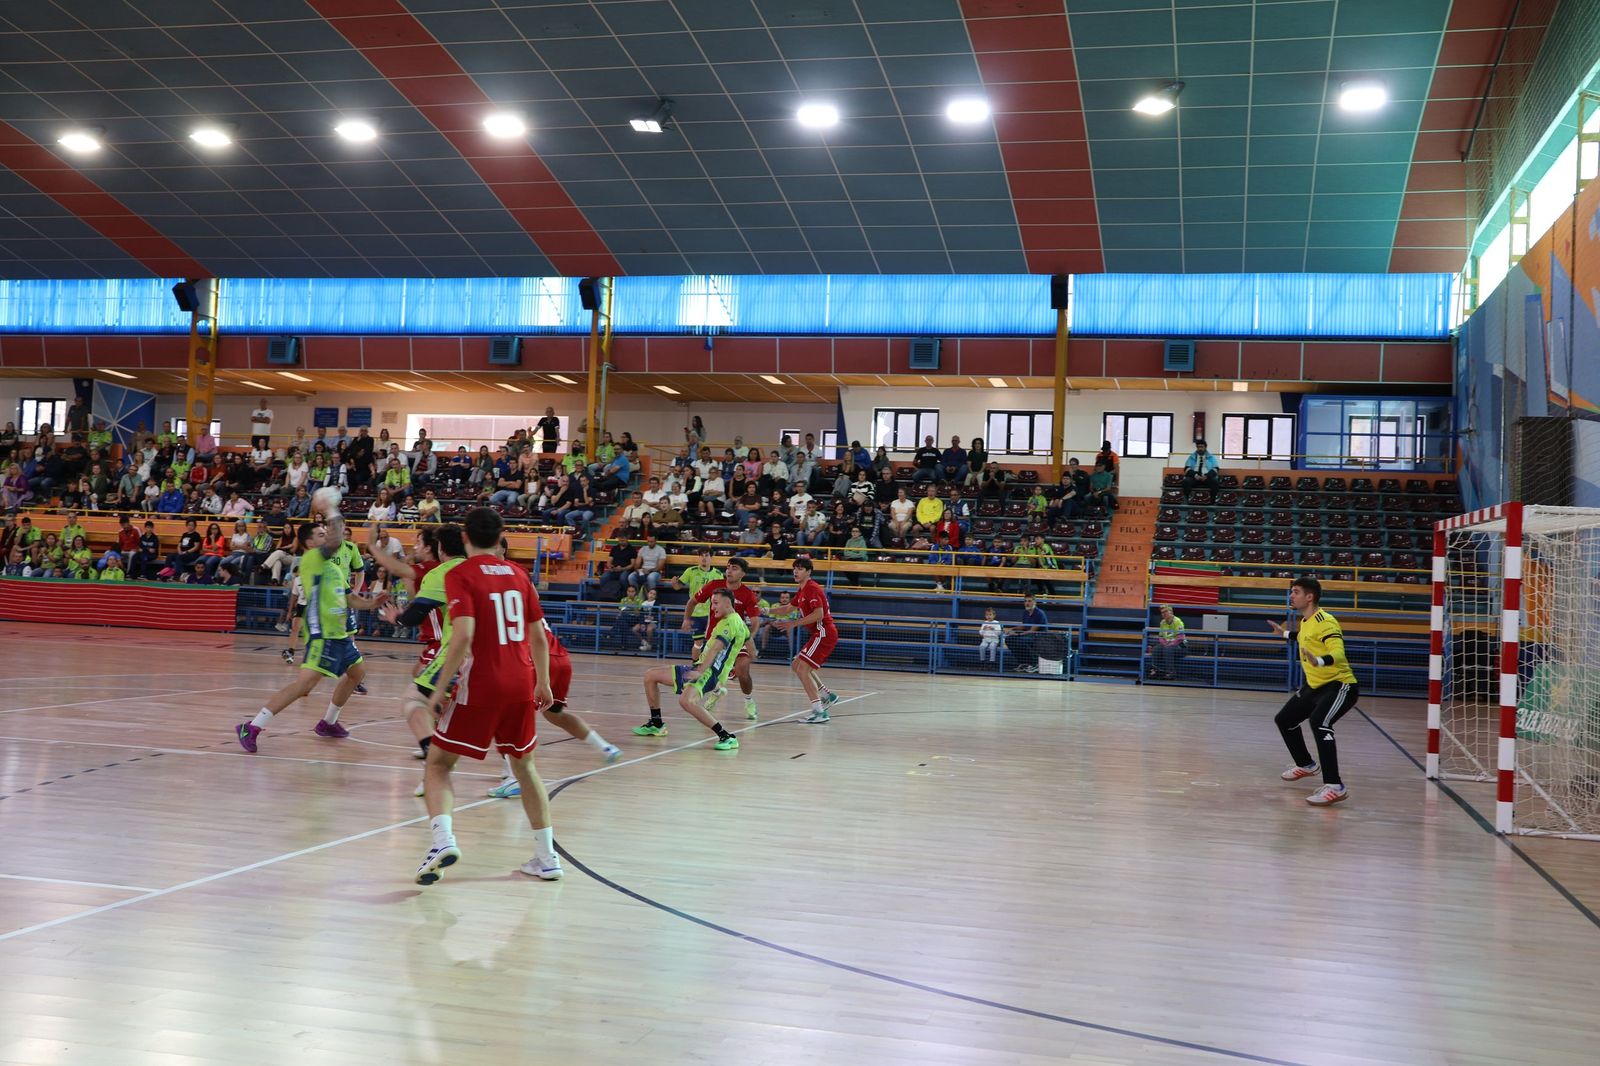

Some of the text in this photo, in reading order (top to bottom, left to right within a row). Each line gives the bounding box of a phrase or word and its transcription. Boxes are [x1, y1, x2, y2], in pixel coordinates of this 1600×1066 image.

[1127, 499, 1146, 507] FILA
[1120, 526, 1139, 534] FILA
[1115, 545, 1135, 553] FILA
[1110, 564, 1130, 572] FILA
[1105, 586, 1126, 594] FILA
[489, 590, 525, 645] 19
